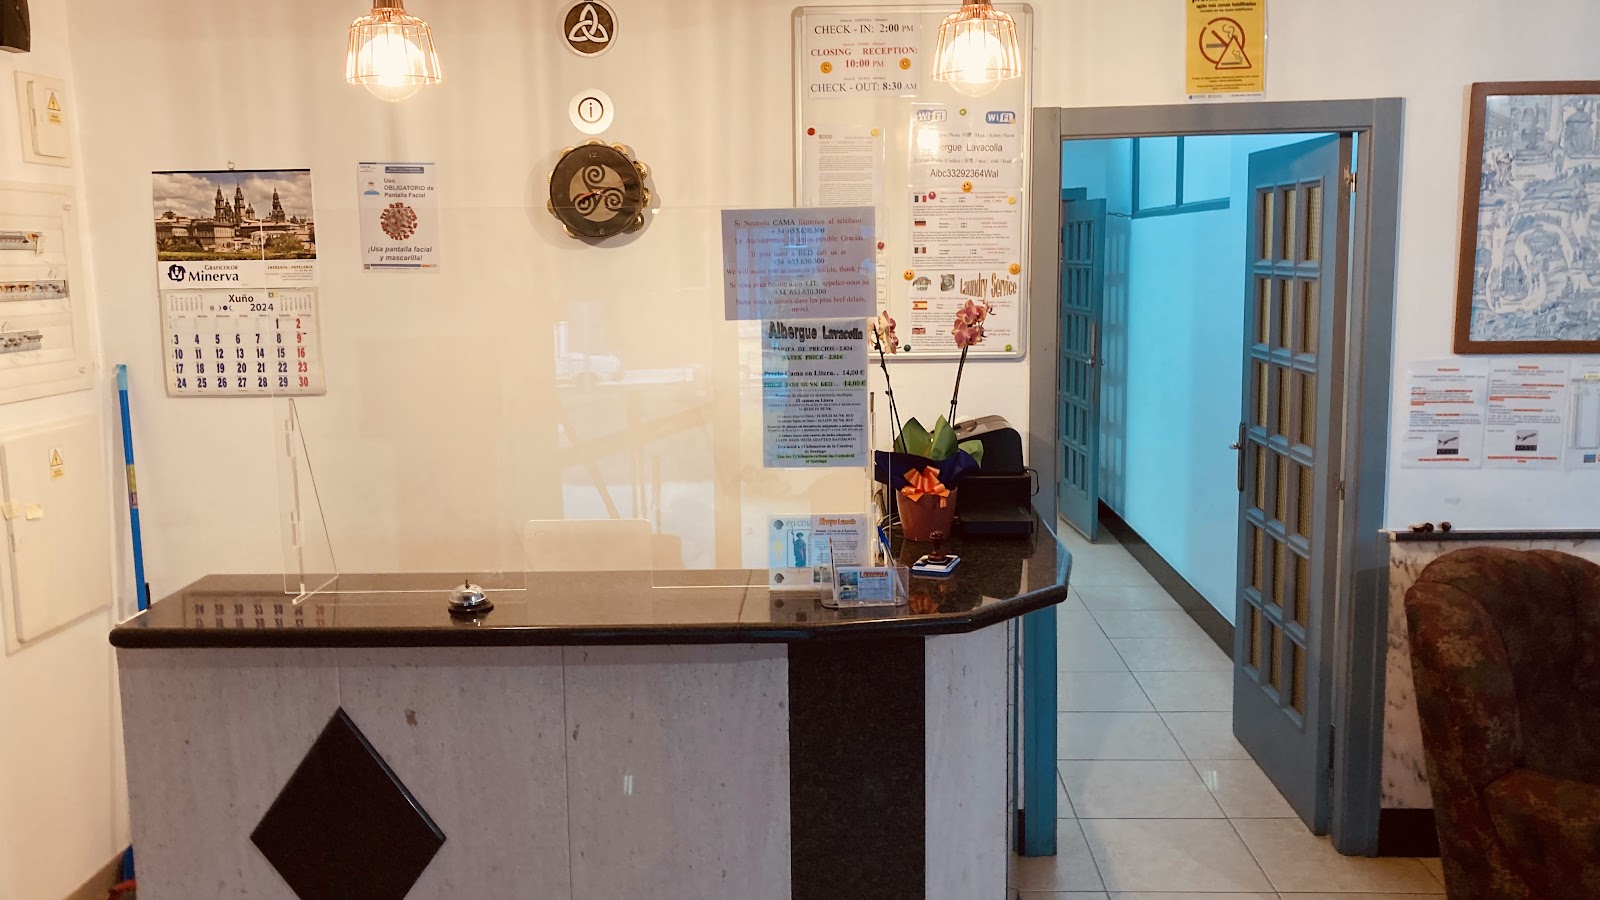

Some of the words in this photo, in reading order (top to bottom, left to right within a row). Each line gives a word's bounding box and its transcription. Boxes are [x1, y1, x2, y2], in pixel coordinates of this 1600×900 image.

[814, 25, 851, 34] CHECK
[860, 24, 874, 33] IN:
[879, 24, 899, 33] 2:00
[810, 48, 852, 56] CLOSING
[862, 47, 918, 55] RECEPTION:
[846, 59, 870, 68] 10:00
[810, 83, 846, 92] CHECK
[855, 82, 880, 91] OUT:
[882, 82, 902, 90] 8:30
[966, 143, 1003, 152] Lavacolla
[188, 271, 239, 282] Minerva
[228, 294, 254, 303] Xuño
[250, 303, 274, 312] 2024
[275, 318, 279, 329] 1
[296, 318, 301, 329] 2
[769, 321, 817, 343] Albergue
[822, 325, 863, 340] Lavacolla
[174, 334, 179, 344] 3
[194, 334, 200, 344] 4
[215, 334, 220, 344] 5
[236, 334, 240, 344] 6
[256, 334, 260, 344] 7
[276, 333, 282, 344] 8
[297, 333, 302, 343] 9
[175, 349, 183, 359] 10
[195, 349, 202, 359] 11
[216, 348, 224, 359] 12
[236, 348, 244, 358] 13
[256, 348, 265, 358] 14
[277, 348, 285, 358] 15
[297, 348, 305, 358] 16
[176, 364, 184, 374] 17
[196, 363, 204, 373] 18
[216, 363, 225, 373] 19
[237, 363, 247, 373] 20
[257, 363, 265, 373] 21
[278, 362, 288, 372] 22
[298, 362, 308, 372] 23
[177, 378, 187, 388] 24
[197, 378, 207, 388] 25
[217, 378, 227, 388] 26
[238, 377, 247, 387] 27
[258, 377, 268, 387] 28
[278, 377, 288, 387] 29
[299, 377, 308, 387] 30
